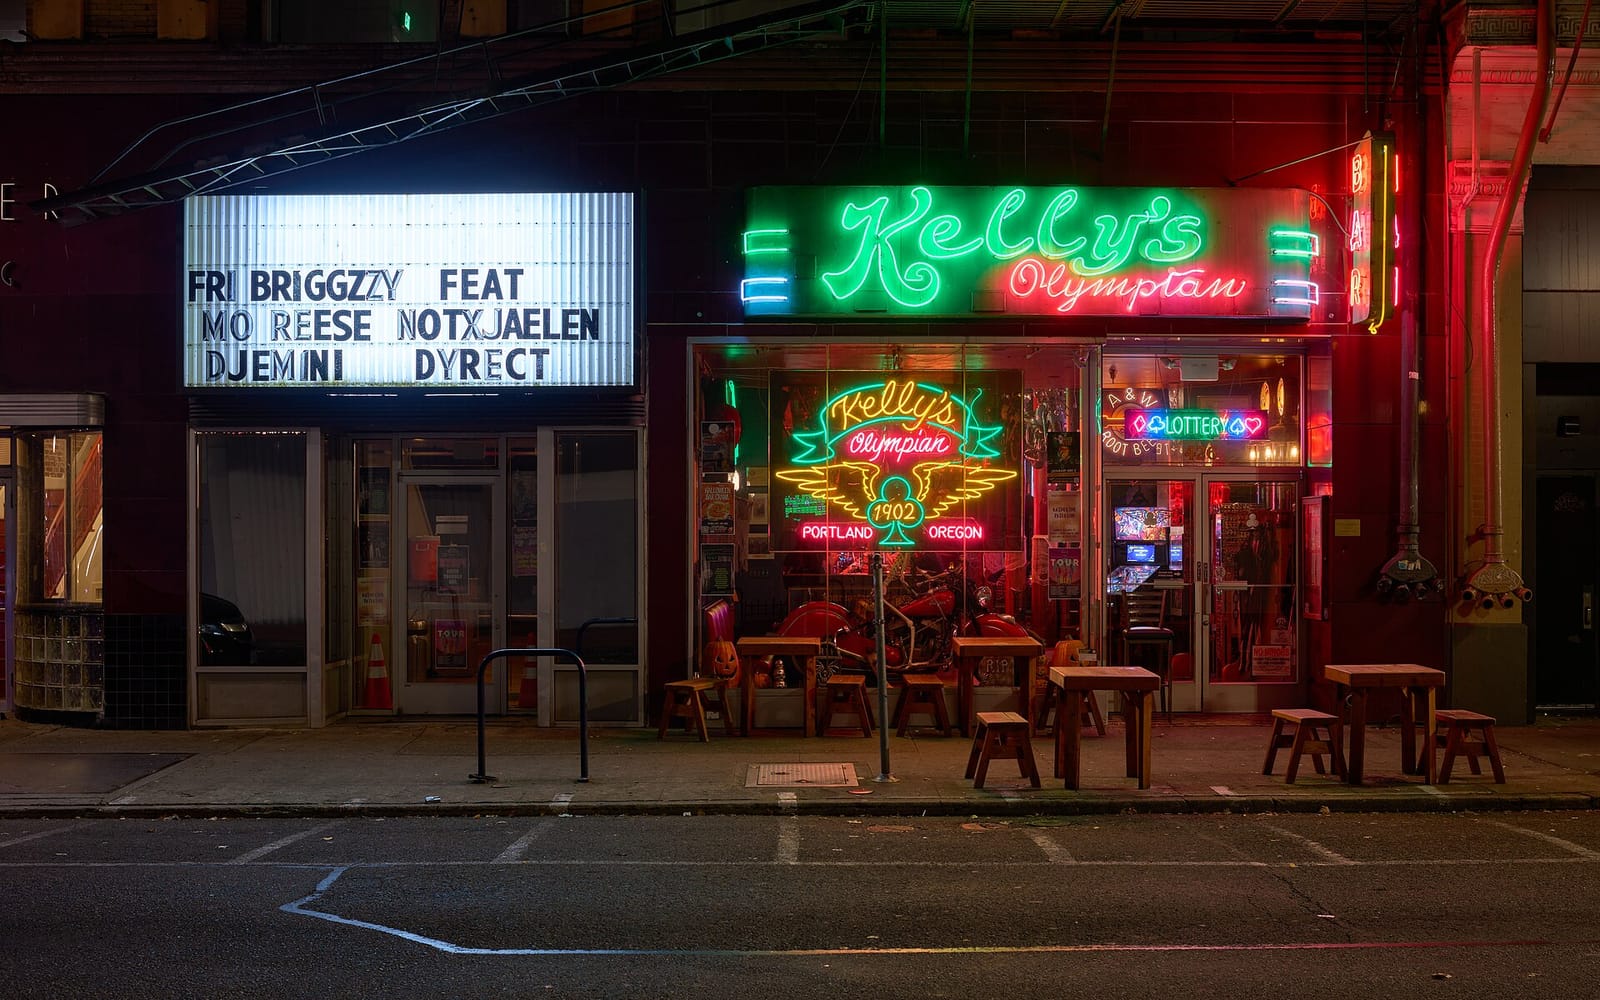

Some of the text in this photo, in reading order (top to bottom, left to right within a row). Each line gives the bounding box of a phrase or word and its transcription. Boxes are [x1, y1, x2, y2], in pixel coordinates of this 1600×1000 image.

[1350, 153, 1364, 307] BAR
[821, 186, 1202, 308] Kelly's
[188, 268, 525, 301] FRI BRIGGZZY FEAT
[202, 308, 600, 341] MO REESE NOTXJAELEN
[206, 348, 551, 381] DJEMINI DYRECT
[832, 380, 956, 431] Kelly's
[1109, 387, 1158, 408] A & W
[1165, 416, 1230, 435] LOTTERY
[849, 431, 950, 462] Olympian
[1102, 430, 1128, 456] ROOT
[873, 503, 916, 521] 1902
[802, 525, 873, 540] PORTLAND
[928, 525, 983, 540] OREGON
[1050, 558, 1080, 568] TOUR
[437, 629, 465, 639] TOUR
